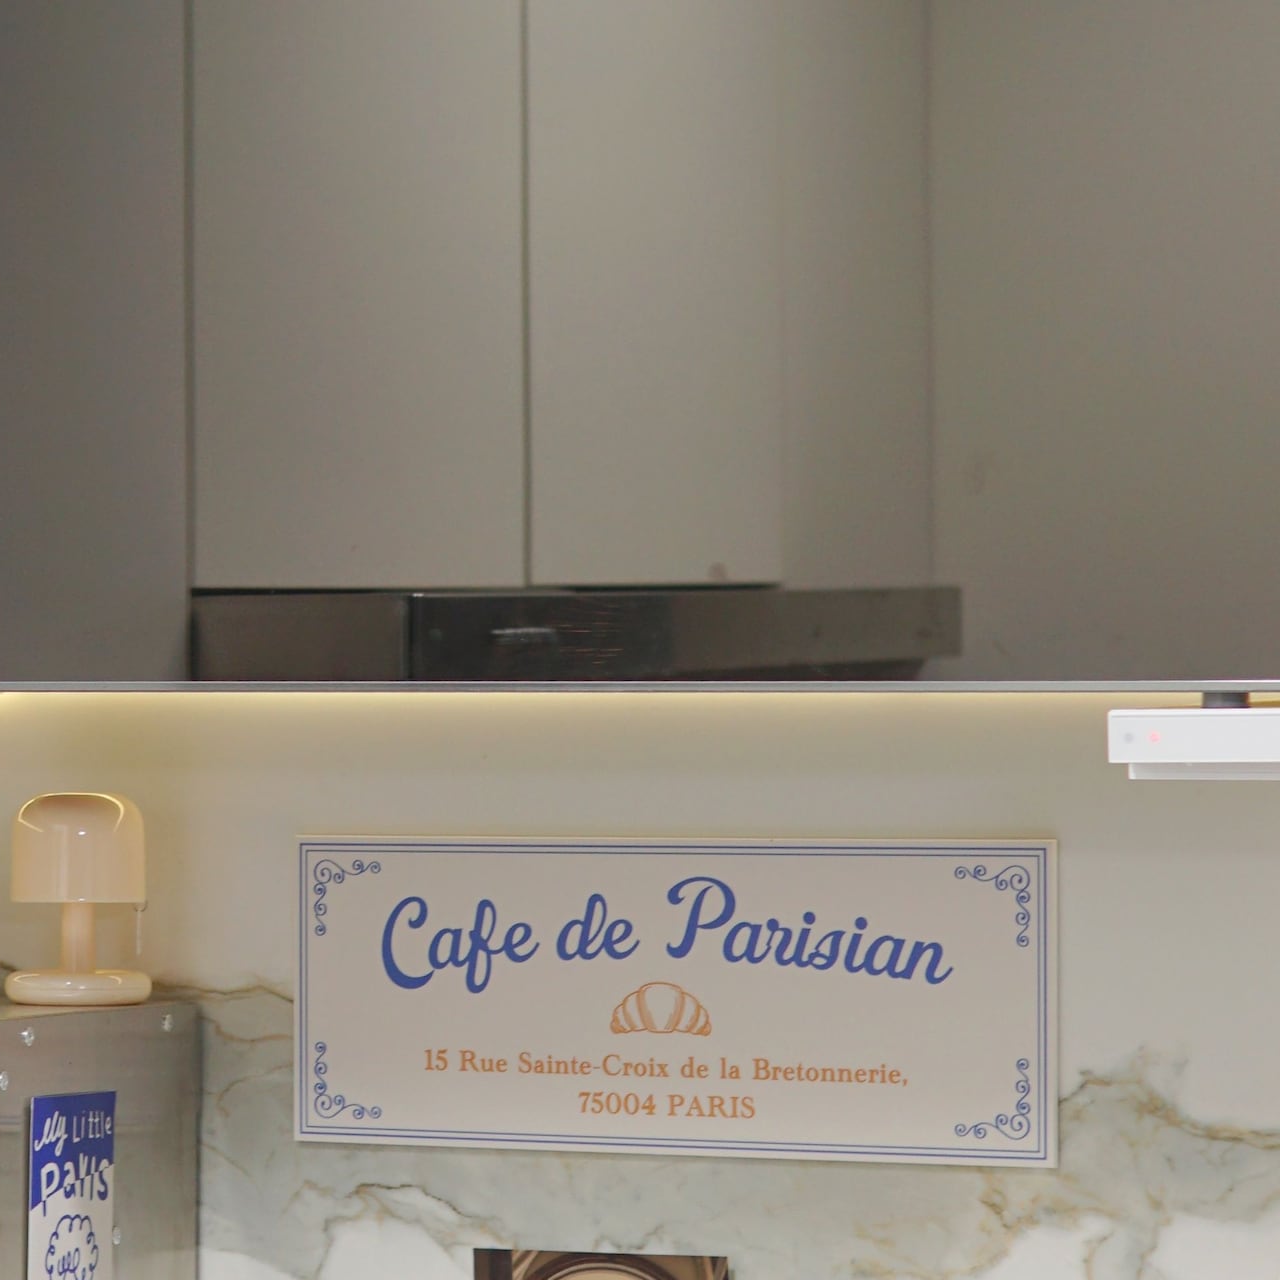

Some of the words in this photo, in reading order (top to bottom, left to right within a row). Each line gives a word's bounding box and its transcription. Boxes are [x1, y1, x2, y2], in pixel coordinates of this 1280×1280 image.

[381, 896, 539, 993] Cafe
[556, 893, 639, 961] de
[666, 876, 953, 984] Parisian
[424, 1048, 449, 1073] 15
[459, 1048, 508, 1074] Rue
[518, 1052, 669, 1079] Sainte-Croix
[680, 1055, 709, 1080] de
[719, 1057, 742, 1081] la
[752, 1057, 909, 1087] Bretonnerie,
[578, 1090, 657, 1117] 75004
[667, 1093, 756, 1120] PARIS
